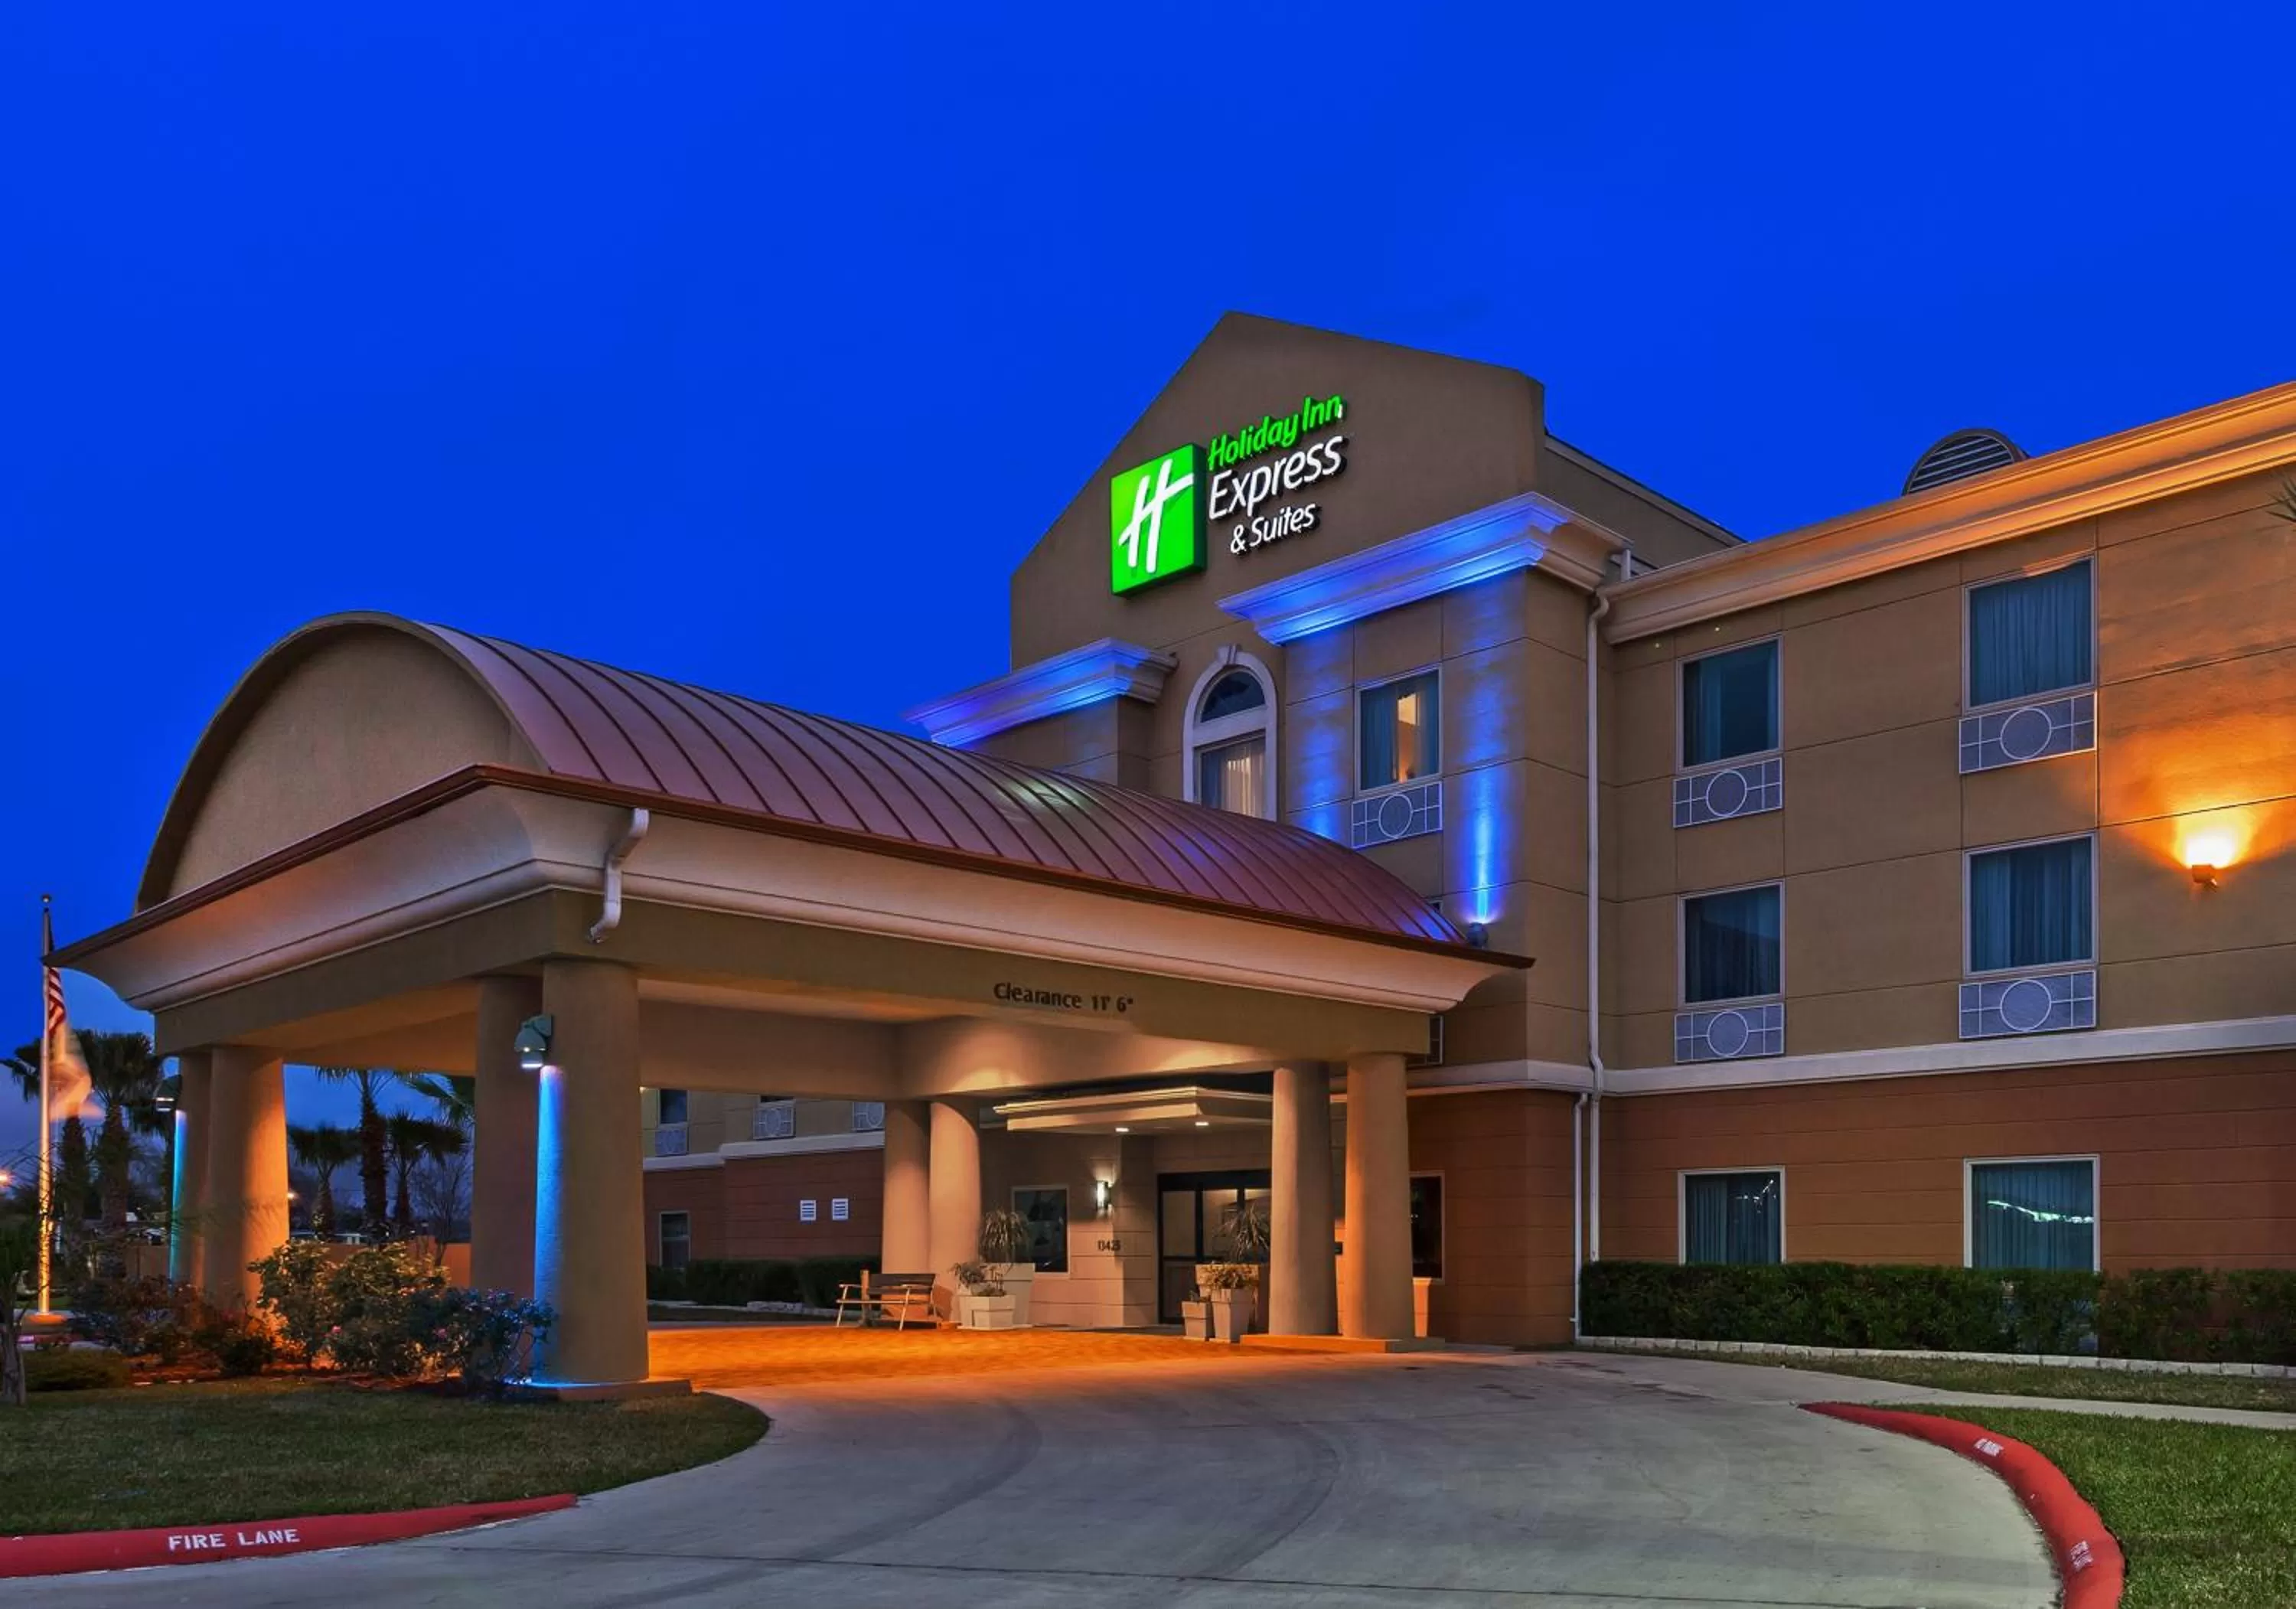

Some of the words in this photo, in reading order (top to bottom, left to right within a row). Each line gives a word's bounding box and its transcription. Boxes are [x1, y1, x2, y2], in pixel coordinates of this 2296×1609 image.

[1208, 414, 1300, 471] Holiday
[1303, 395, 1344, 432] Inn
[1209, 436, 1343, 521] Express
[1230, 524, 1248, 554] &
[1251, 504, 1316, 548] Suites
[993, 982, 1082, 1008] Clearance
[168, 1533, 227, 1552] FIRE
[236, 1529, 301, 1546] LANE
